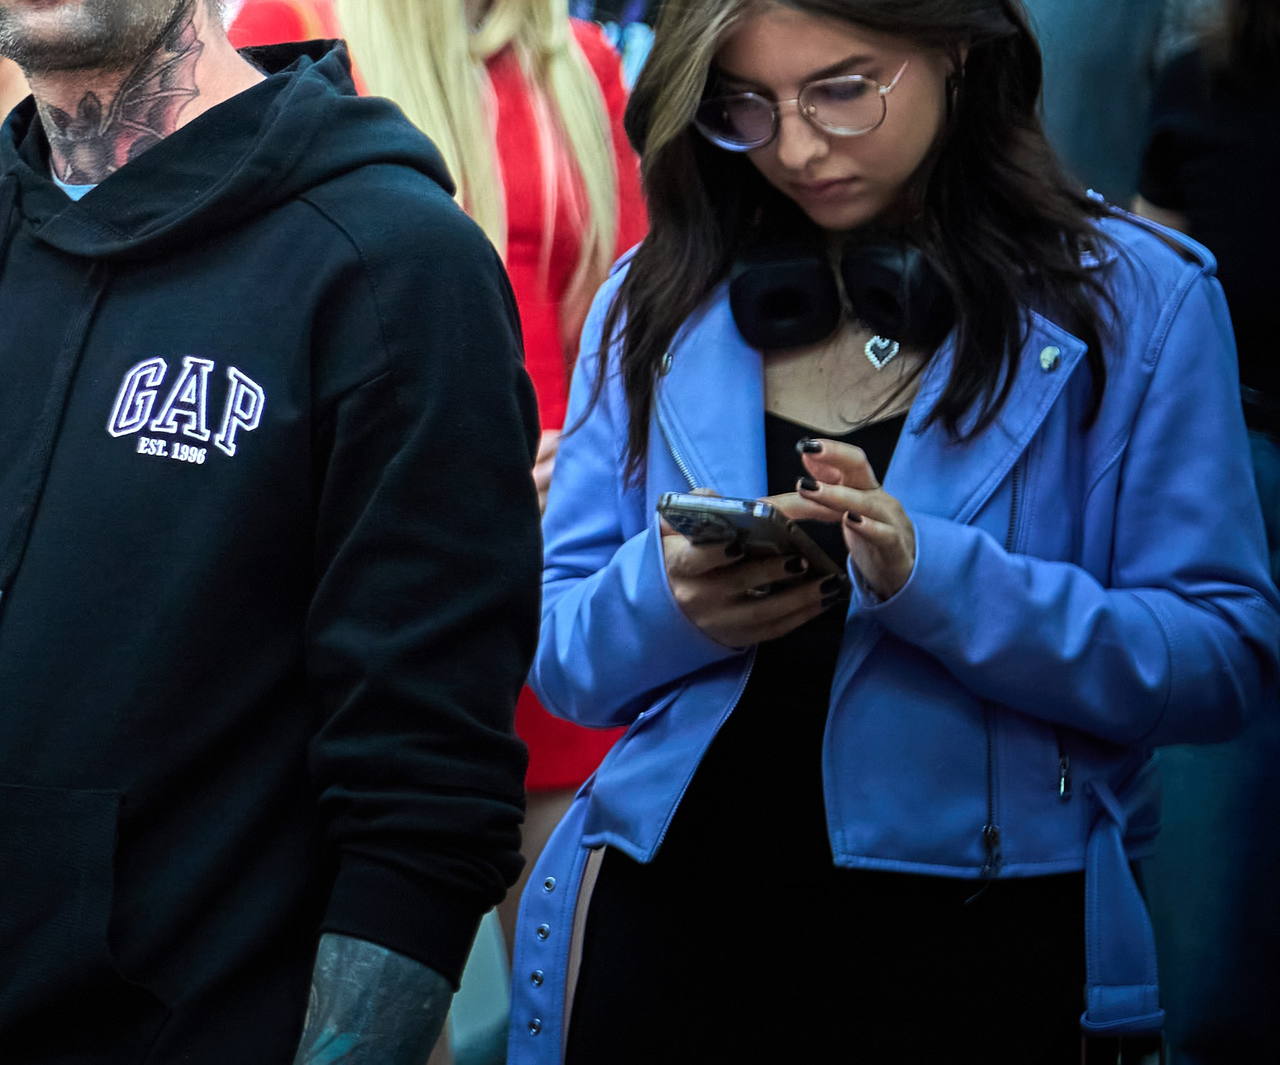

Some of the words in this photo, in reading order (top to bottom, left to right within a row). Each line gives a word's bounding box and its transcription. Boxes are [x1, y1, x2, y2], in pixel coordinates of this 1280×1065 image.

[107, 356, 265, 457] GAP
[137, 436, 168, 456] EST.
[171, 442, 207, 465] 1996
